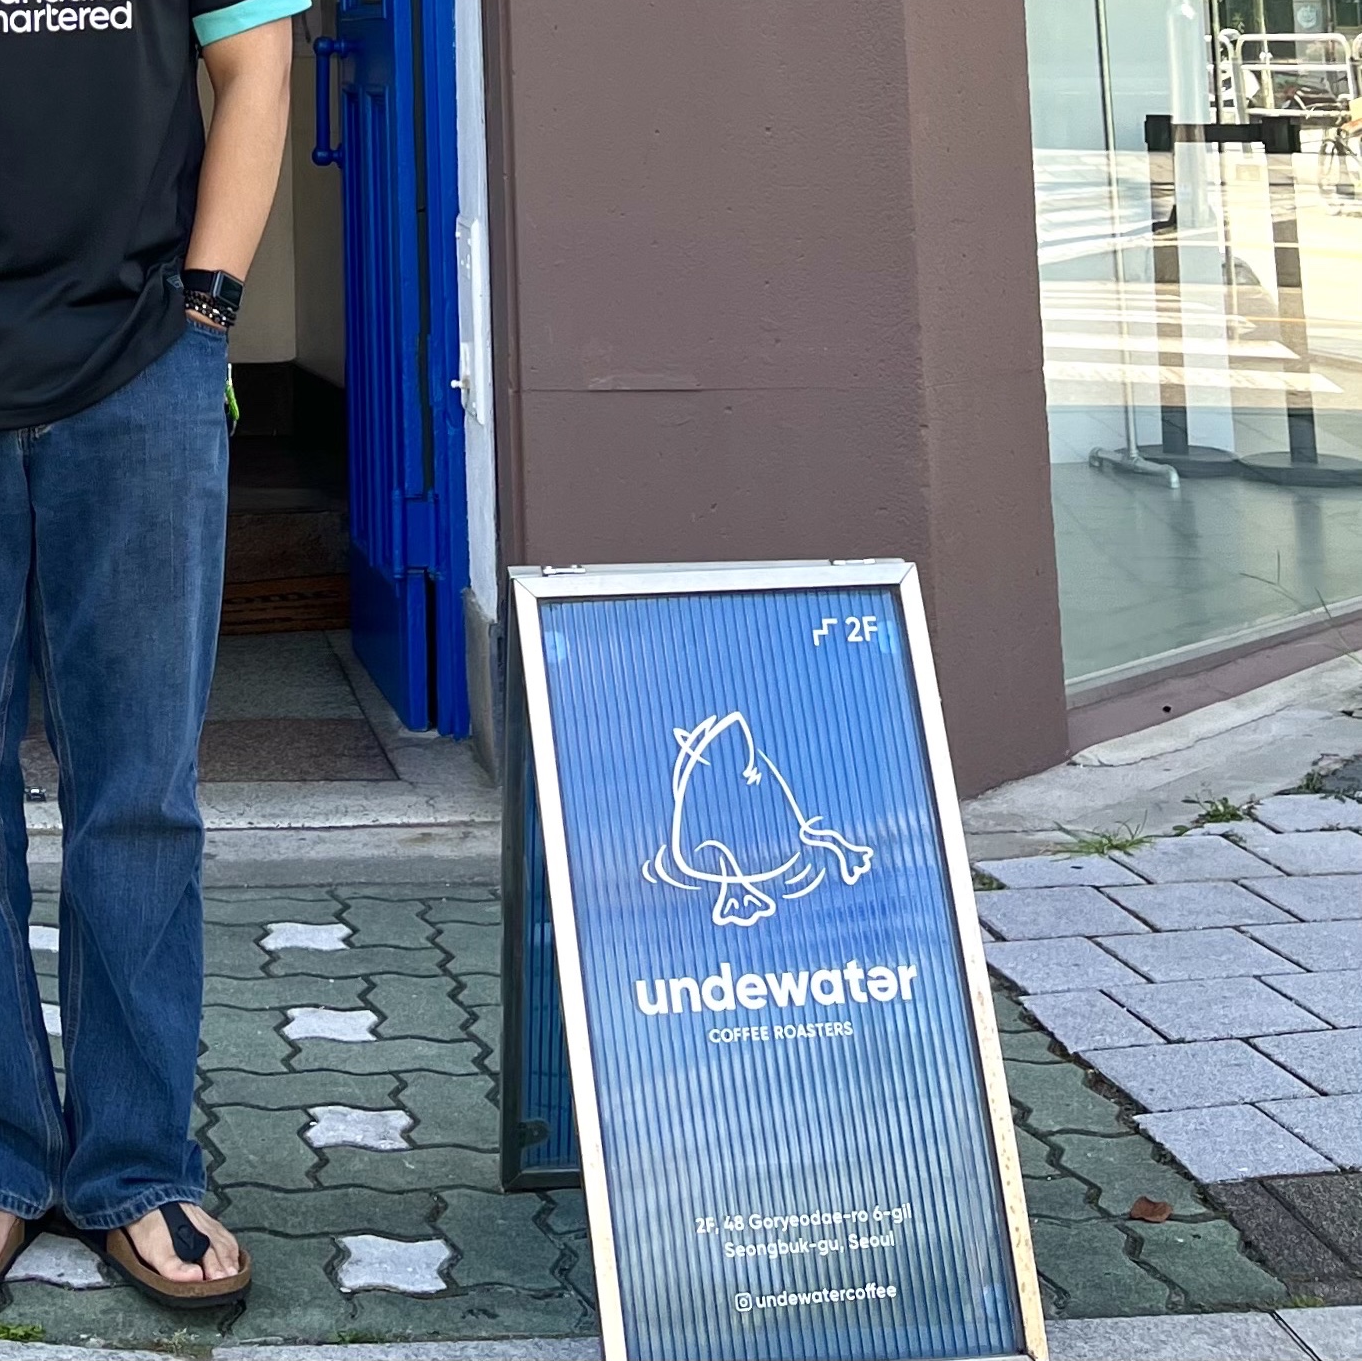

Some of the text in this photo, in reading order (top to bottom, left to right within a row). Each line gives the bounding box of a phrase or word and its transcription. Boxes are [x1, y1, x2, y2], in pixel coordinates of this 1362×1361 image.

[845, 616, 877, 642] 2F
[709, 1021, 853, 1043] COFFEE ROASTERS
[695, 1203, 912, 1234] 2F, 48 Goryeodae-ro 6-gil
[725, 1230, 895, 1259] Seongbuk-gu, Seoul
[755, 1282, 897, 1308] undewatercoffee
